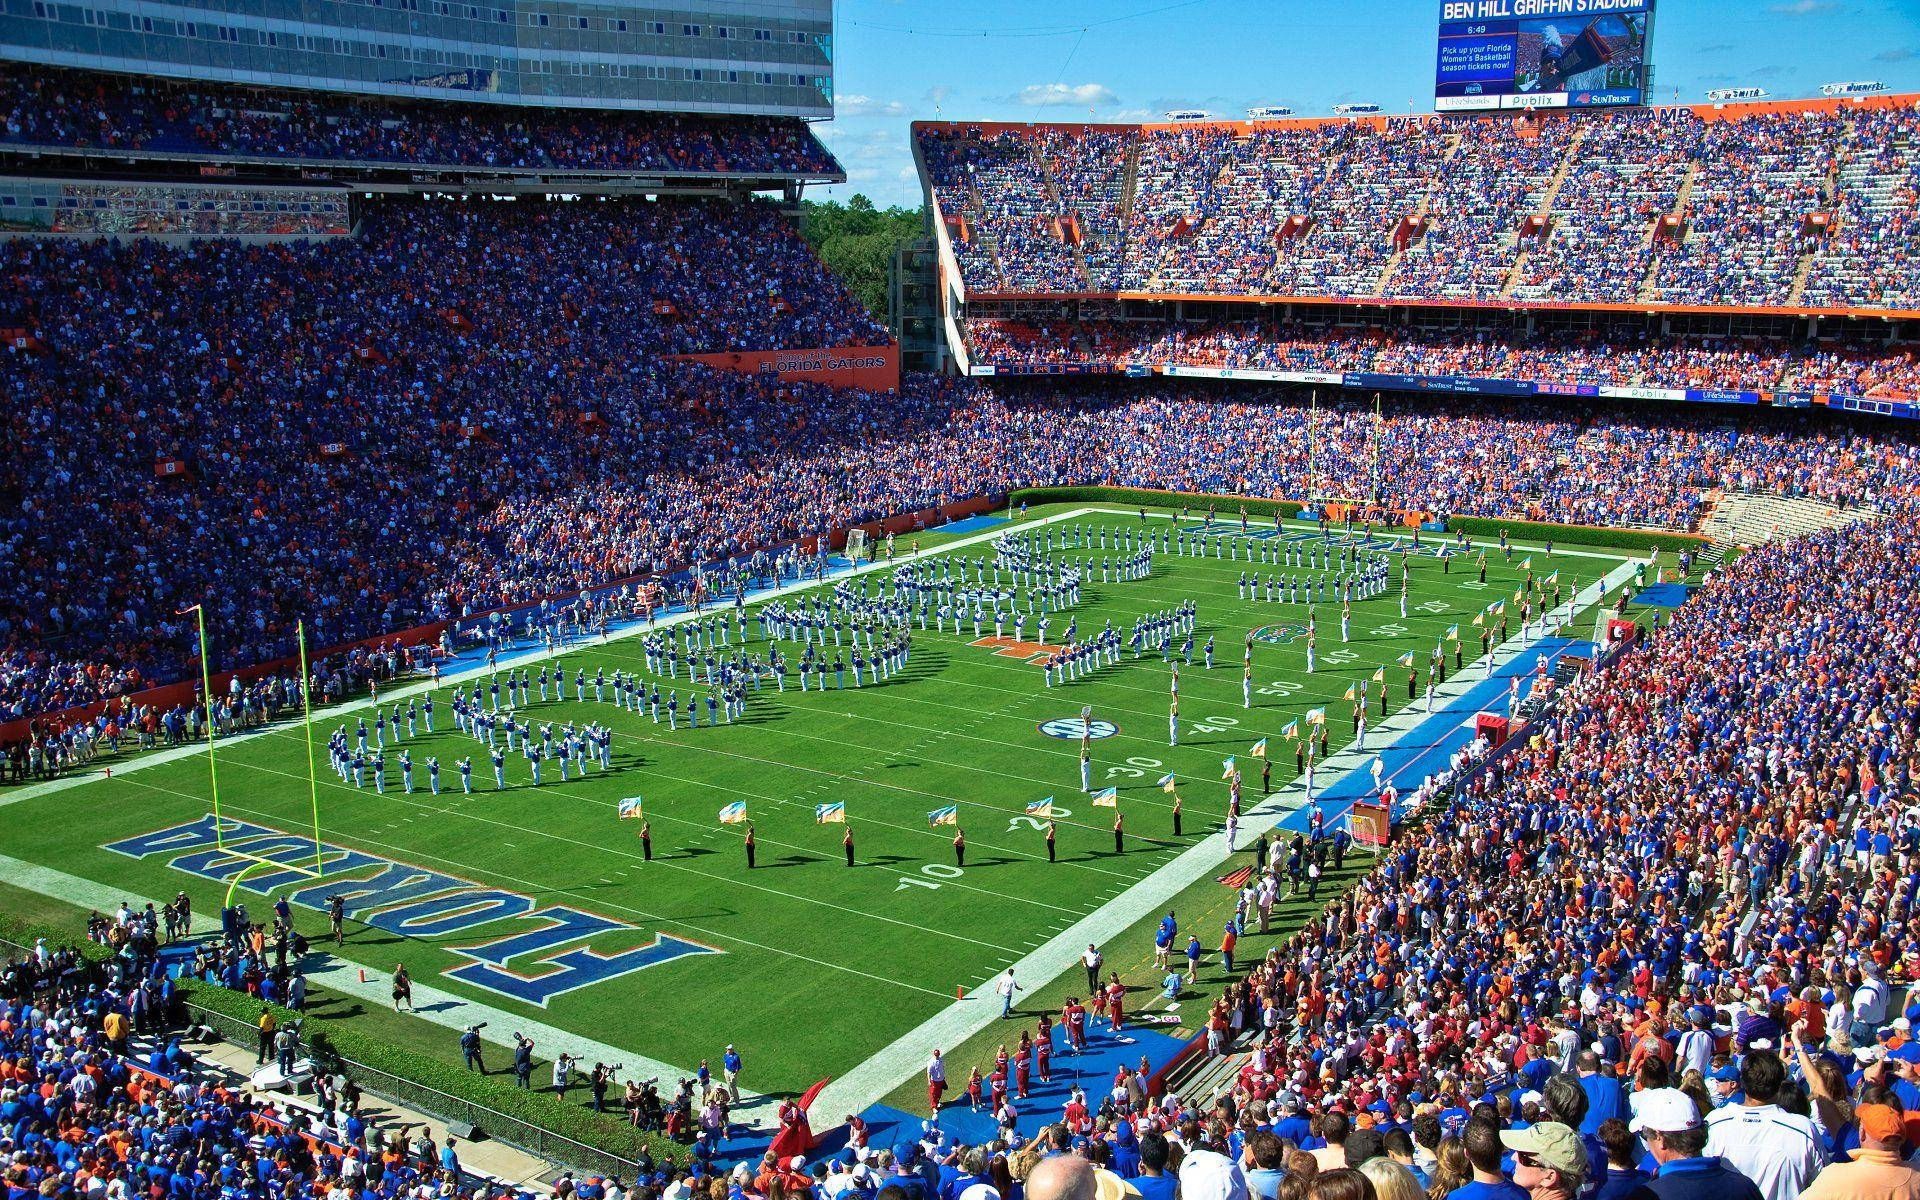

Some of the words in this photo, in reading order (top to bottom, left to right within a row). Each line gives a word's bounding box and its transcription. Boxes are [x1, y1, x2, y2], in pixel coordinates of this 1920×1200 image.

[1443, 2, 1474, 20] BEN
[1478, 0, 1510, 18] HILL
[1514, 0, 1573, 16] GRIFFIN
[1467, 25, 1486, 34] 6:49
[1442, 46, 1457, 54] Pick
[1469, 47, 1485, 55] your
[1486, 44, 1512, 52] Florida
[1441, 54, 1473, 63] Women's
[1474, 53, 1511, 61] Basketball
[1467, 62, 1491, 70] tickets
[1492, 61, 1510, 69] now!
[1511, 95, 1553, 106] Publix
[776, 352, 804, 361] Home
[805, 352, 815, 360] of
[817, 351, 831, 360] the
[759, 360, 824, 373] FLORIDA
[826, 357, 887, 370] GATORS
[1631, 388, 1669, 399] Publix
[1414, 600, 1452, 613] 20
[1370, 622, 1408, 637] 30
[1321, 649, 1360, 665] 40
[1257, 681, 1304, 697] 50
[1189, 716, 1239, 735] 40
[1108, 756, 1163, 779] 30
[896, 863, 964, 891] 10
[99, 812, 728, 1009] FLORIDA
